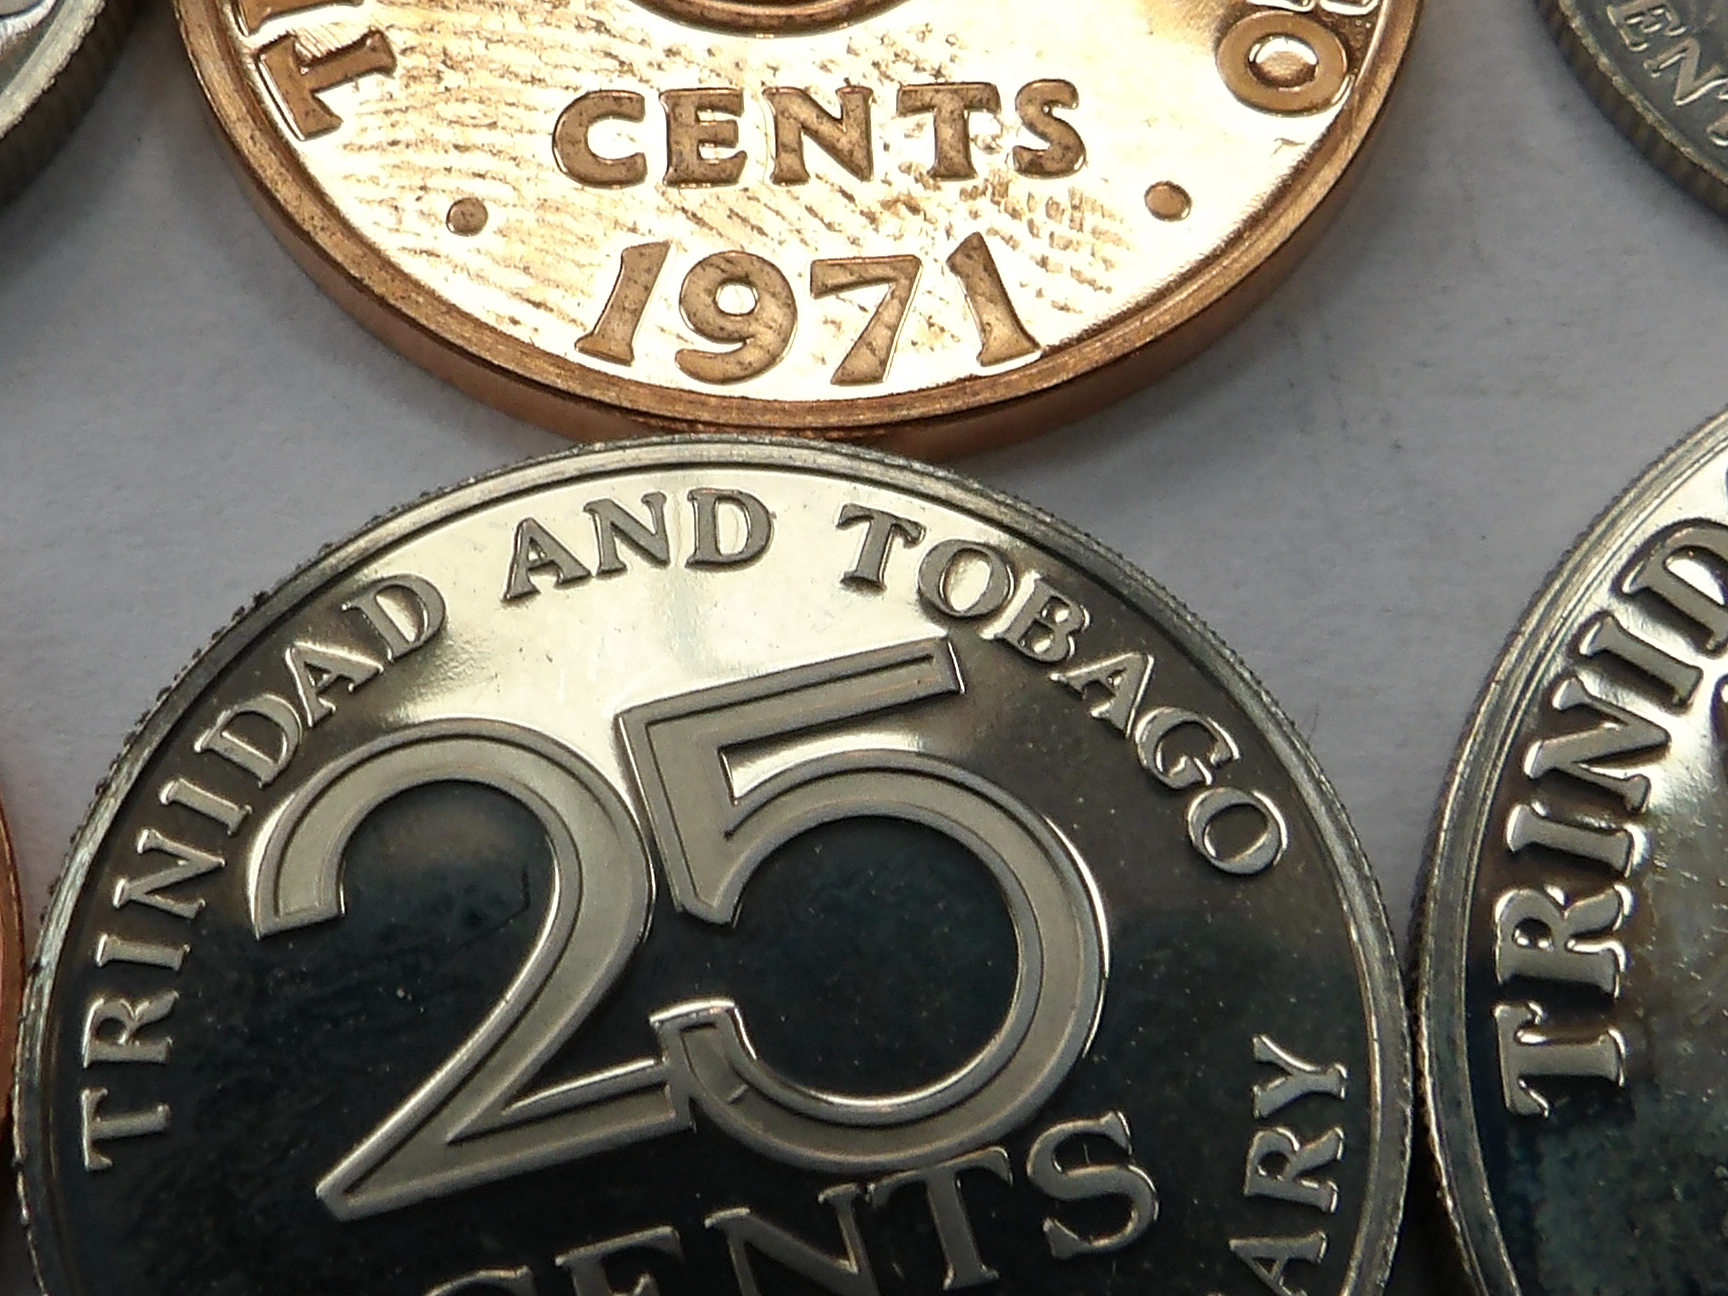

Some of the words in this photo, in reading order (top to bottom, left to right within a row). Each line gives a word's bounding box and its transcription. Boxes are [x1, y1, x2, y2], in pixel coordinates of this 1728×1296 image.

[551, 78, 1090, 189] CENTS
[573, 231, 1042, 388] 1971
[78, 571, 448, 1173] TRINIDAD
[502, 488, 773, 604] AND
[835, 502, 1290, 881] TOBAGO
[247, 634, 1112, 1223] 25
